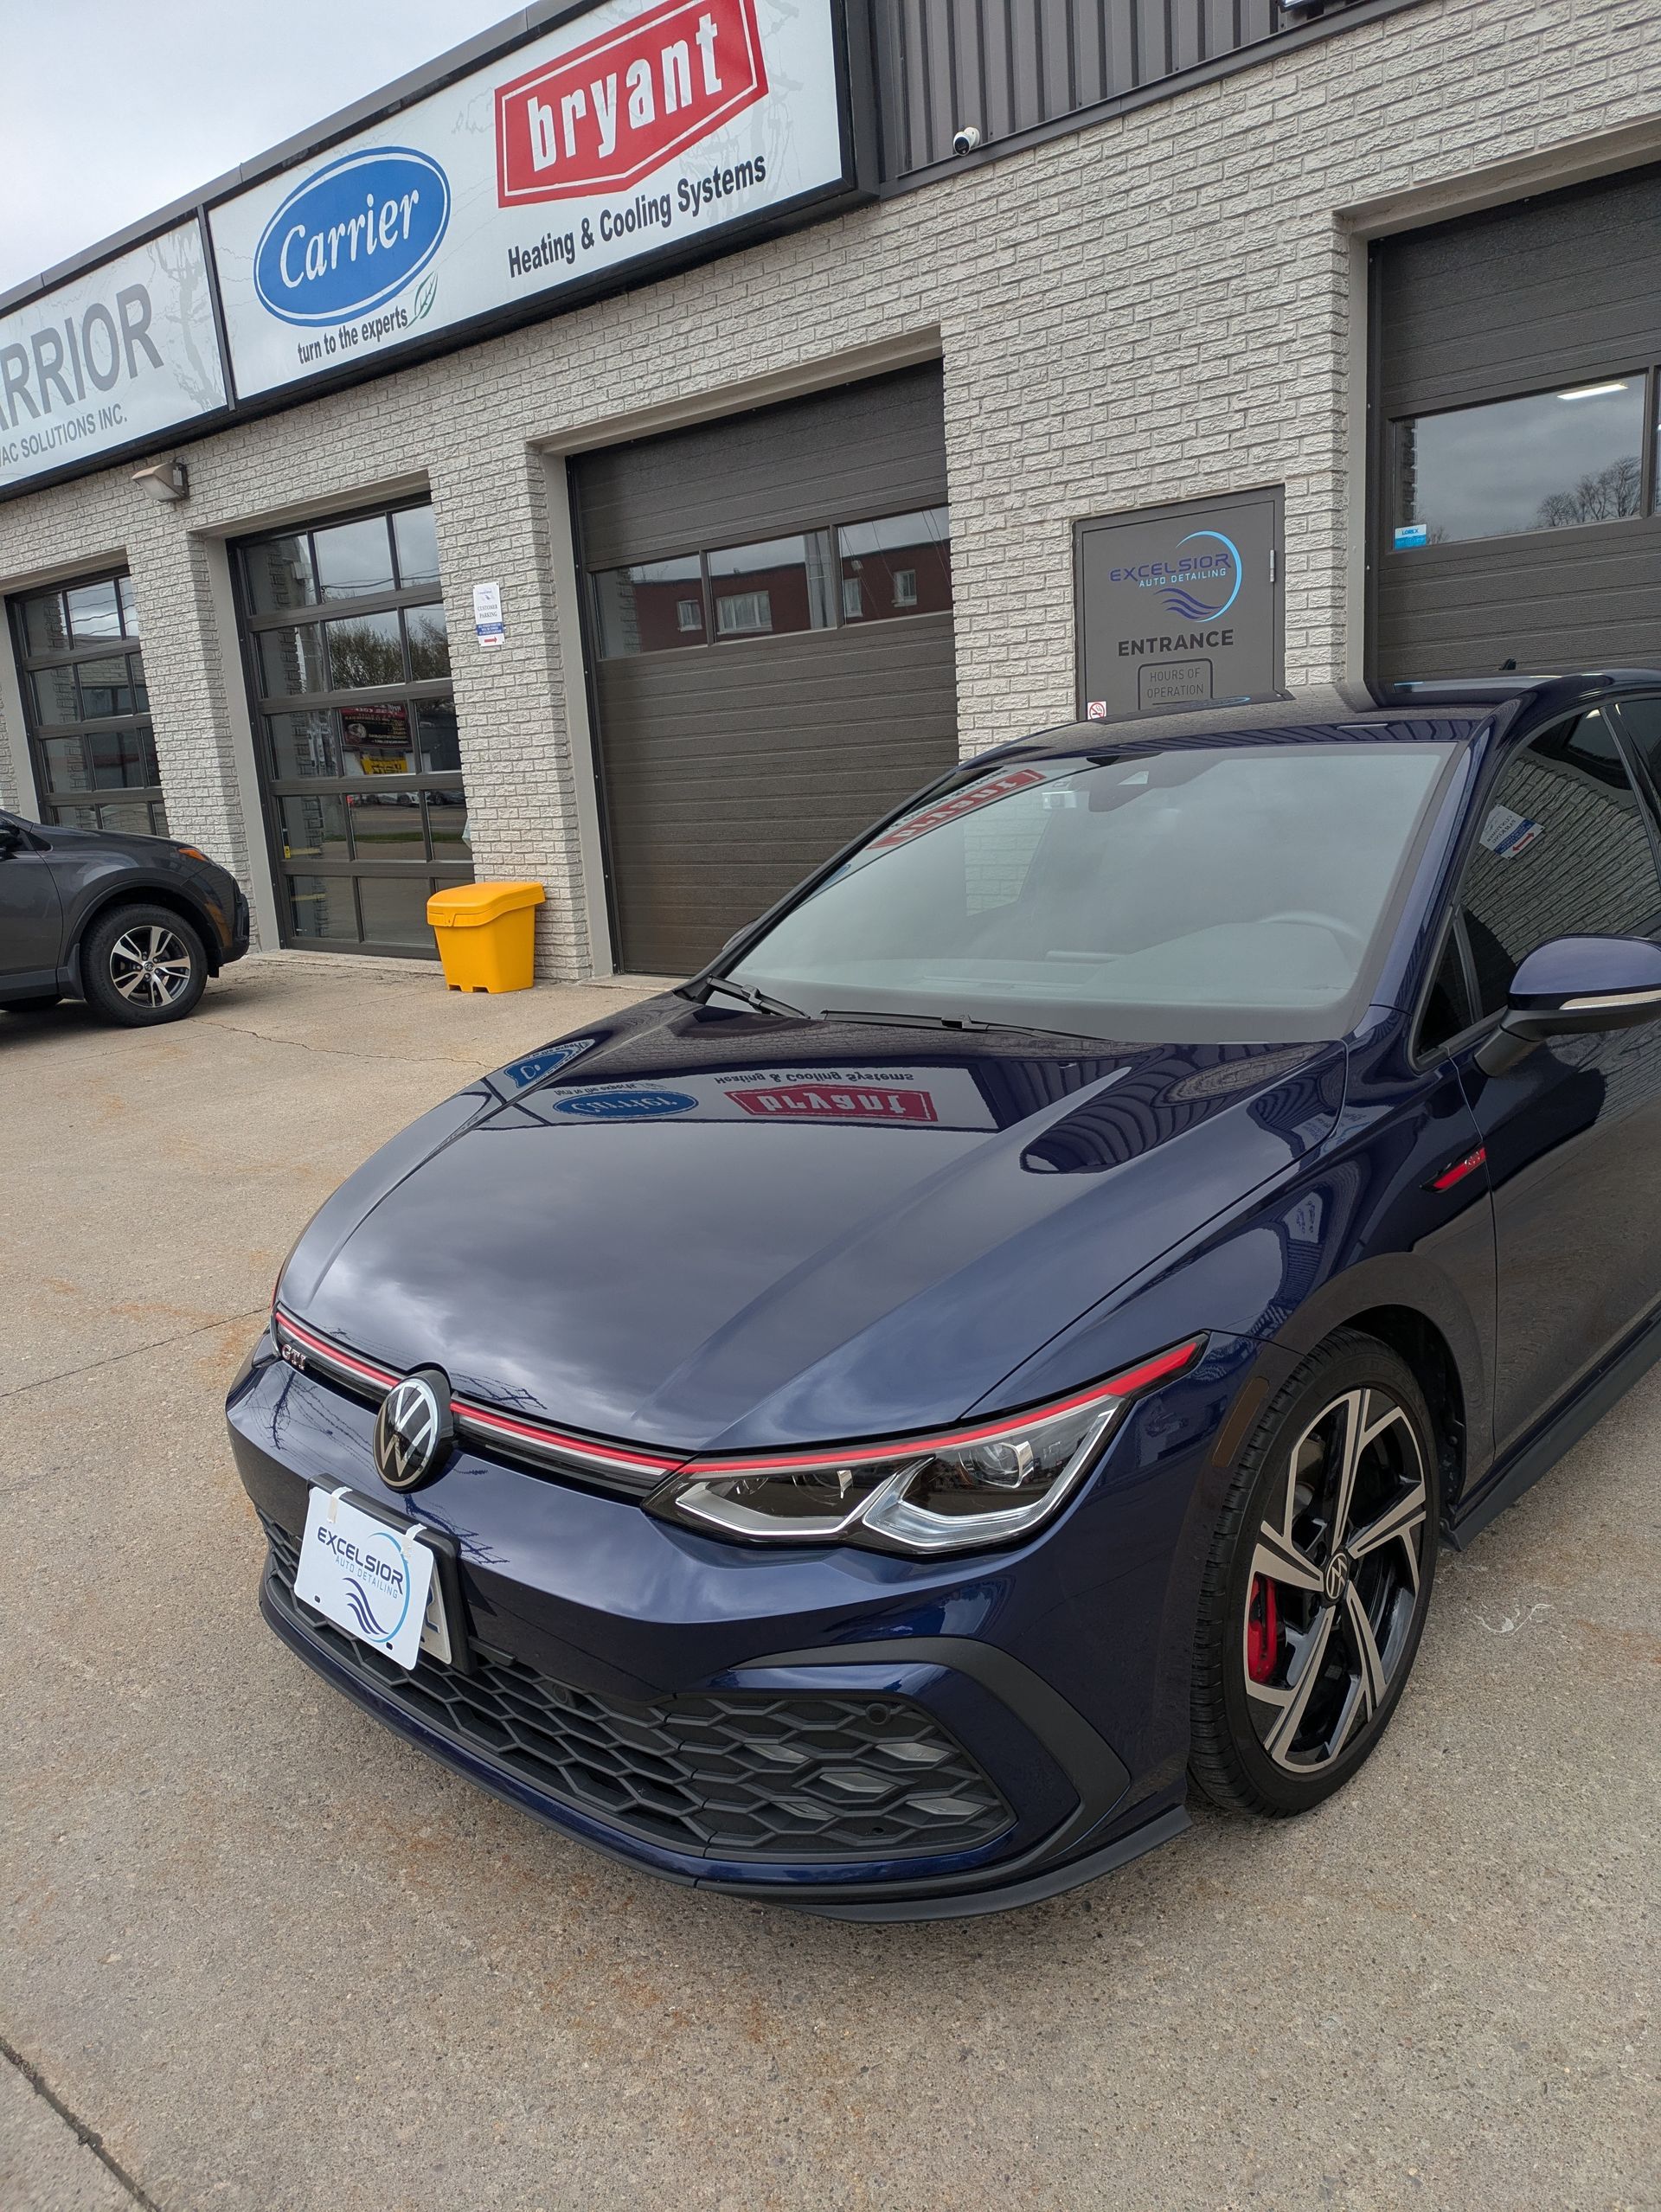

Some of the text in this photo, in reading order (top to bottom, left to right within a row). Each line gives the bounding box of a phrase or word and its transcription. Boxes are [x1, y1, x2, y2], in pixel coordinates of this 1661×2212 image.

[527, 13, 723, 172] bryant
[279, 188, 420, 289] Carrier
[508, 155, 766, 278] Heating & Cooling Systems
[0, 284, 164, 431] RRIOR
[297, 305, 408, 364] turn to the experts
[21, 414, 96, 458] SOLUTIONS
[99, 403, 127, 430] INC.
[1110, 554, 1232, 581] EXCELSIOR
[1138, 567, 1227, 588] AUTO DETAILING
[1118, 629, 1234, 657] ENTRANCE
[1147, 684, 1203, 698] OPERATION
[1150, 668, 1201, 682] HOURS OF
[282, 1343, 306, 1370] GTI
[317, 1526, 403, 1594] EXCELSIOR
[335, 1555, 398, 1599] AUTO DETAILING
